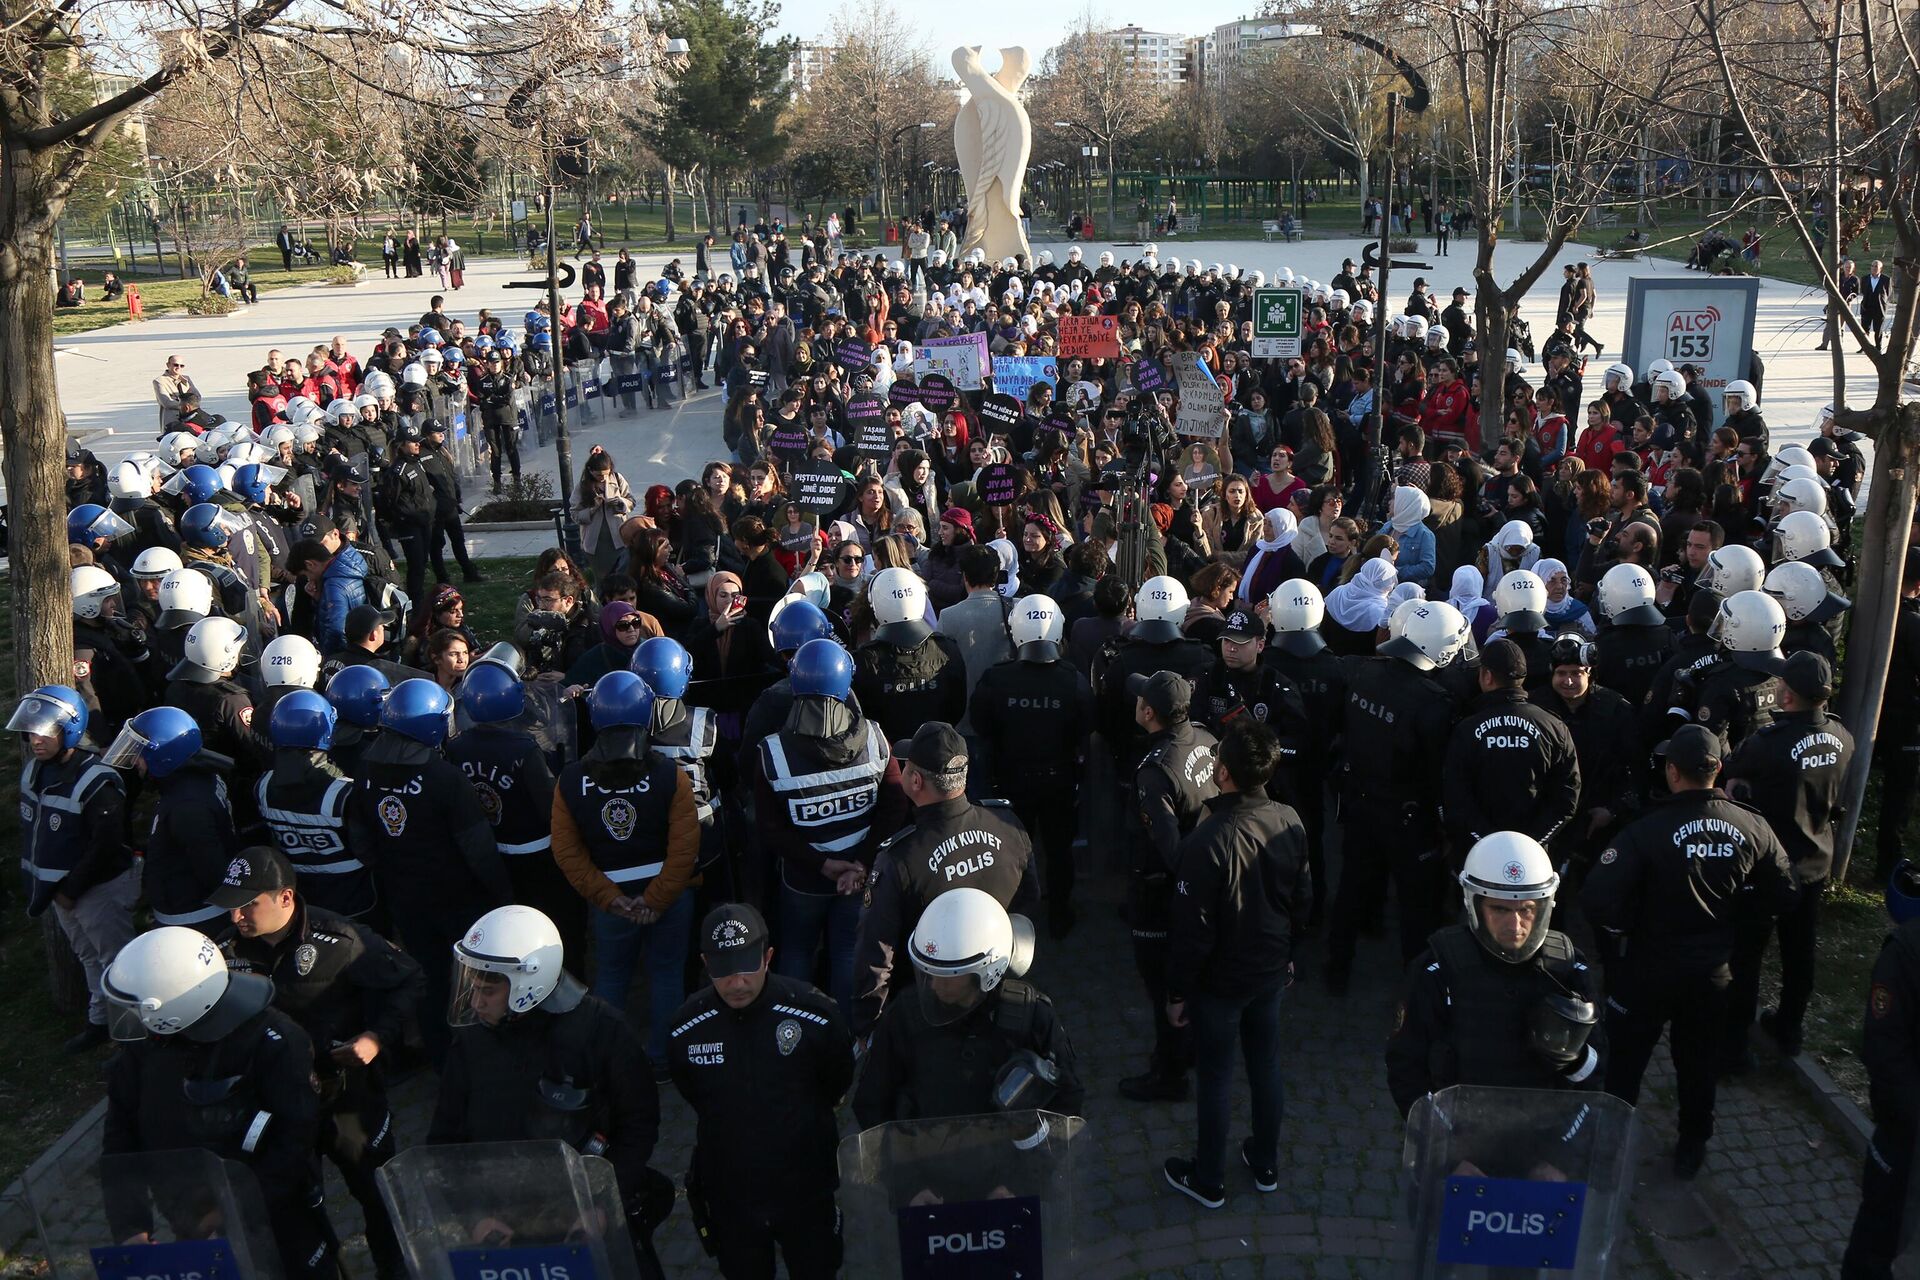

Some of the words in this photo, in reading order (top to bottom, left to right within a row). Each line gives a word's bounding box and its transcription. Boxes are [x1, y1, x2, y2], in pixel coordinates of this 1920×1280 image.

[1670, 336, 1709, 357] 153
[992, 466, 1006, 476] JIN
[819, 486, 836, 494] DIDE
[986, 478, 1013, 489] JIYAN
[163, 580, 179, 590] 1617
[1511, 581, 1535, 590] 1322
[892, 587, 913, 599] 1615
[1150, 591, 1172, 601] 1321
[1293, 597, 1314, 606] 1121
[1026, 611, 1053, 620] 1207
[271, 656, 292, 665] 2218
[1007, 696, 1061, 709] POLİS
[1351, 692, 1395, 723] POLİS
[1474, 716, 1502, 741] ÇEVİK
[1503, 715, 1541, 740] KUVVET
[1486, 736, 1529, 749] POLİS
[1791, 733, 1815, 761] ÇEVİK
[1816, 732, 1844, 753] KUVVET
[1801, 752, 1837, 770] POLİS
[802, 792, 869, 819] POLİS
[1673, 820, 1704, 847] ÇEVİK
[1706, 818, 1746, 846] KUVVET
[928, 835, 959, 874] ÇEVİK
[957, 830, 1002, 851] KUVVET
[1686, 843, 1734, 859] POLİS
[944, 851, 995, 882] POLİS
[718, 936, 745, 949] POLİS
[515, 992, 534, 1008] 21
[702, 1042, 723, 1054] KUVVET
[688, 1054, 725, 1065] POLİS
[1468, 1210, 1545, 1235] POLİS
[928, 1229, 1006, 1255] POLİS
